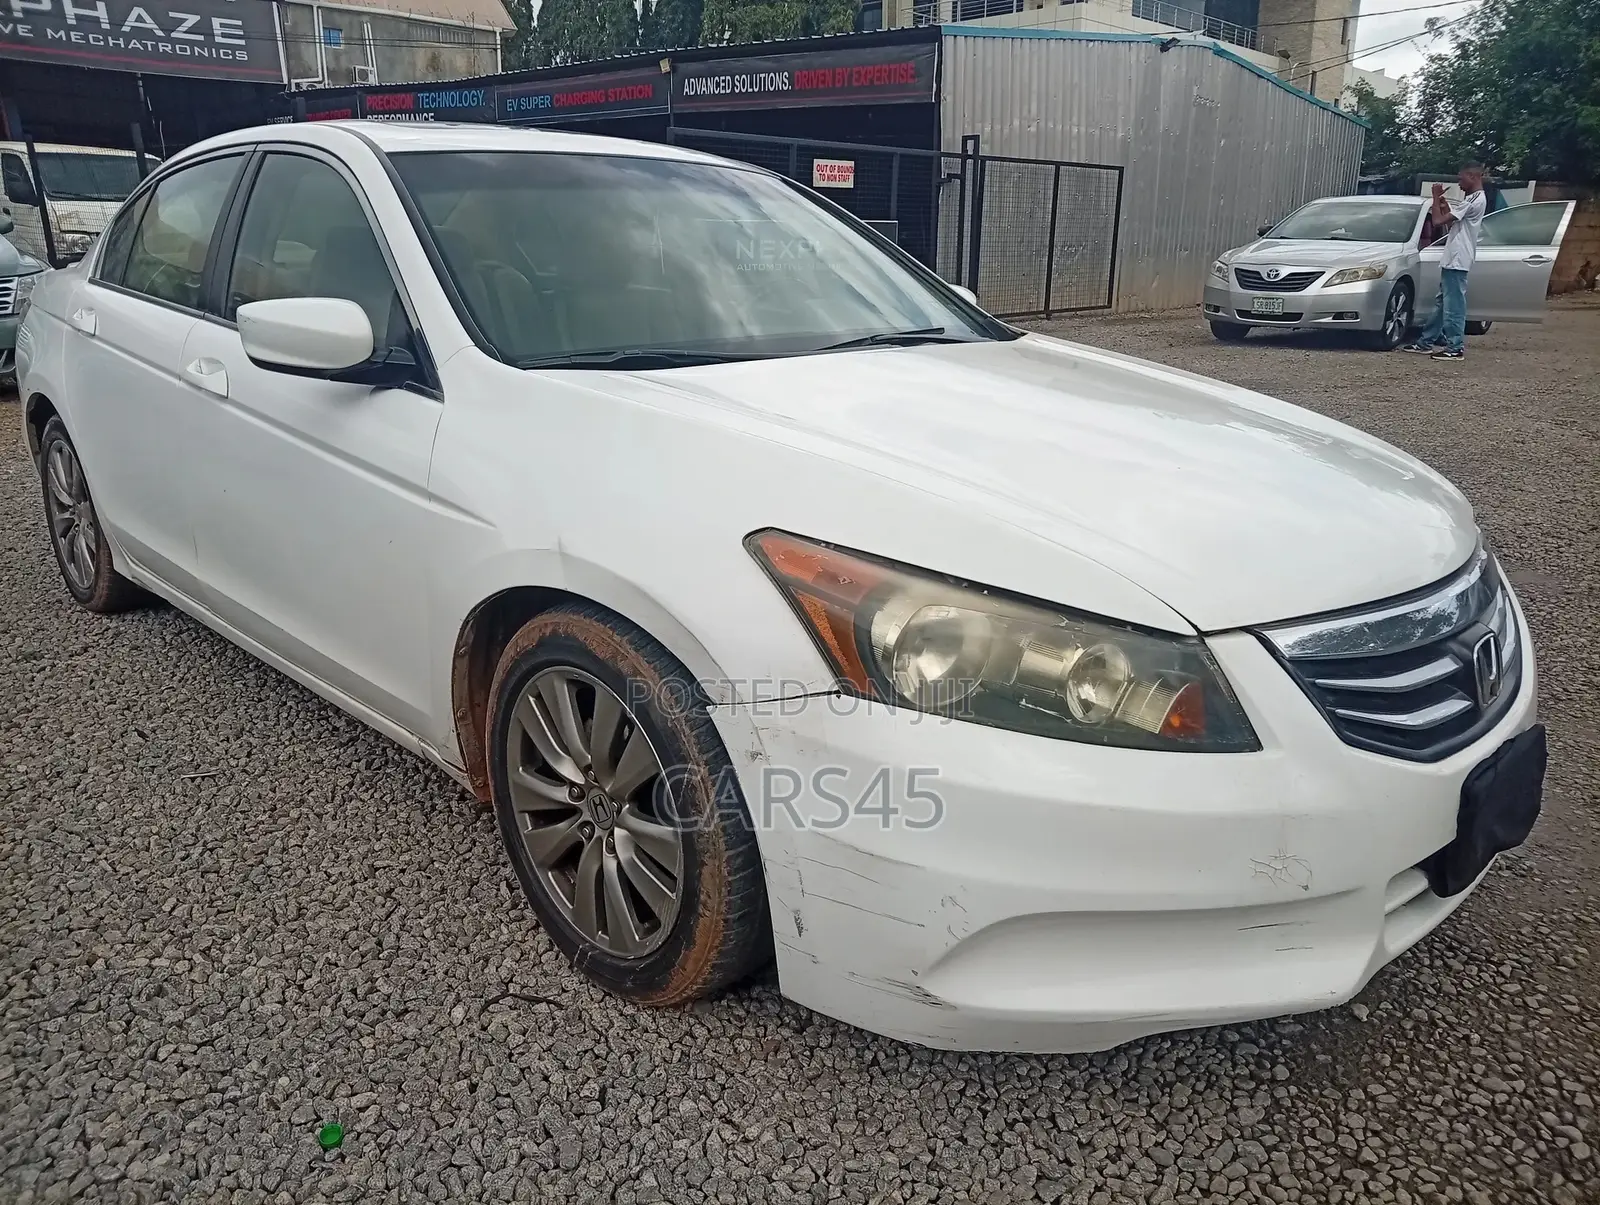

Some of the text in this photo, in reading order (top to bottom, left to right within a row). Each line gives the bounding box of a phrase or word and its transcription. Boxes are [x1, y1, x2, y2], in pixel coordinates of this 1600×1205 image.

[0, 0, 247, 46] PHAZE
[47, 27, 249, 61] MECHATRONICS
[683, 75, 732, 96] ADVANCED
[734, 71, 792, 93] SOLUTIONS.
[794, 68, 833, 90] DRIVEN
[835, 67, 850, 87] BY
[366, 89, 486, 111] PRECISION TECHNOLOGY.
[506, 83, 653, 112] EV SUPER CHARGING STATION
[816, 164, 828, 173] OUT
[829, 164, 836, 173] OF
[819, 173, 850, 182] TO NON STAFF
